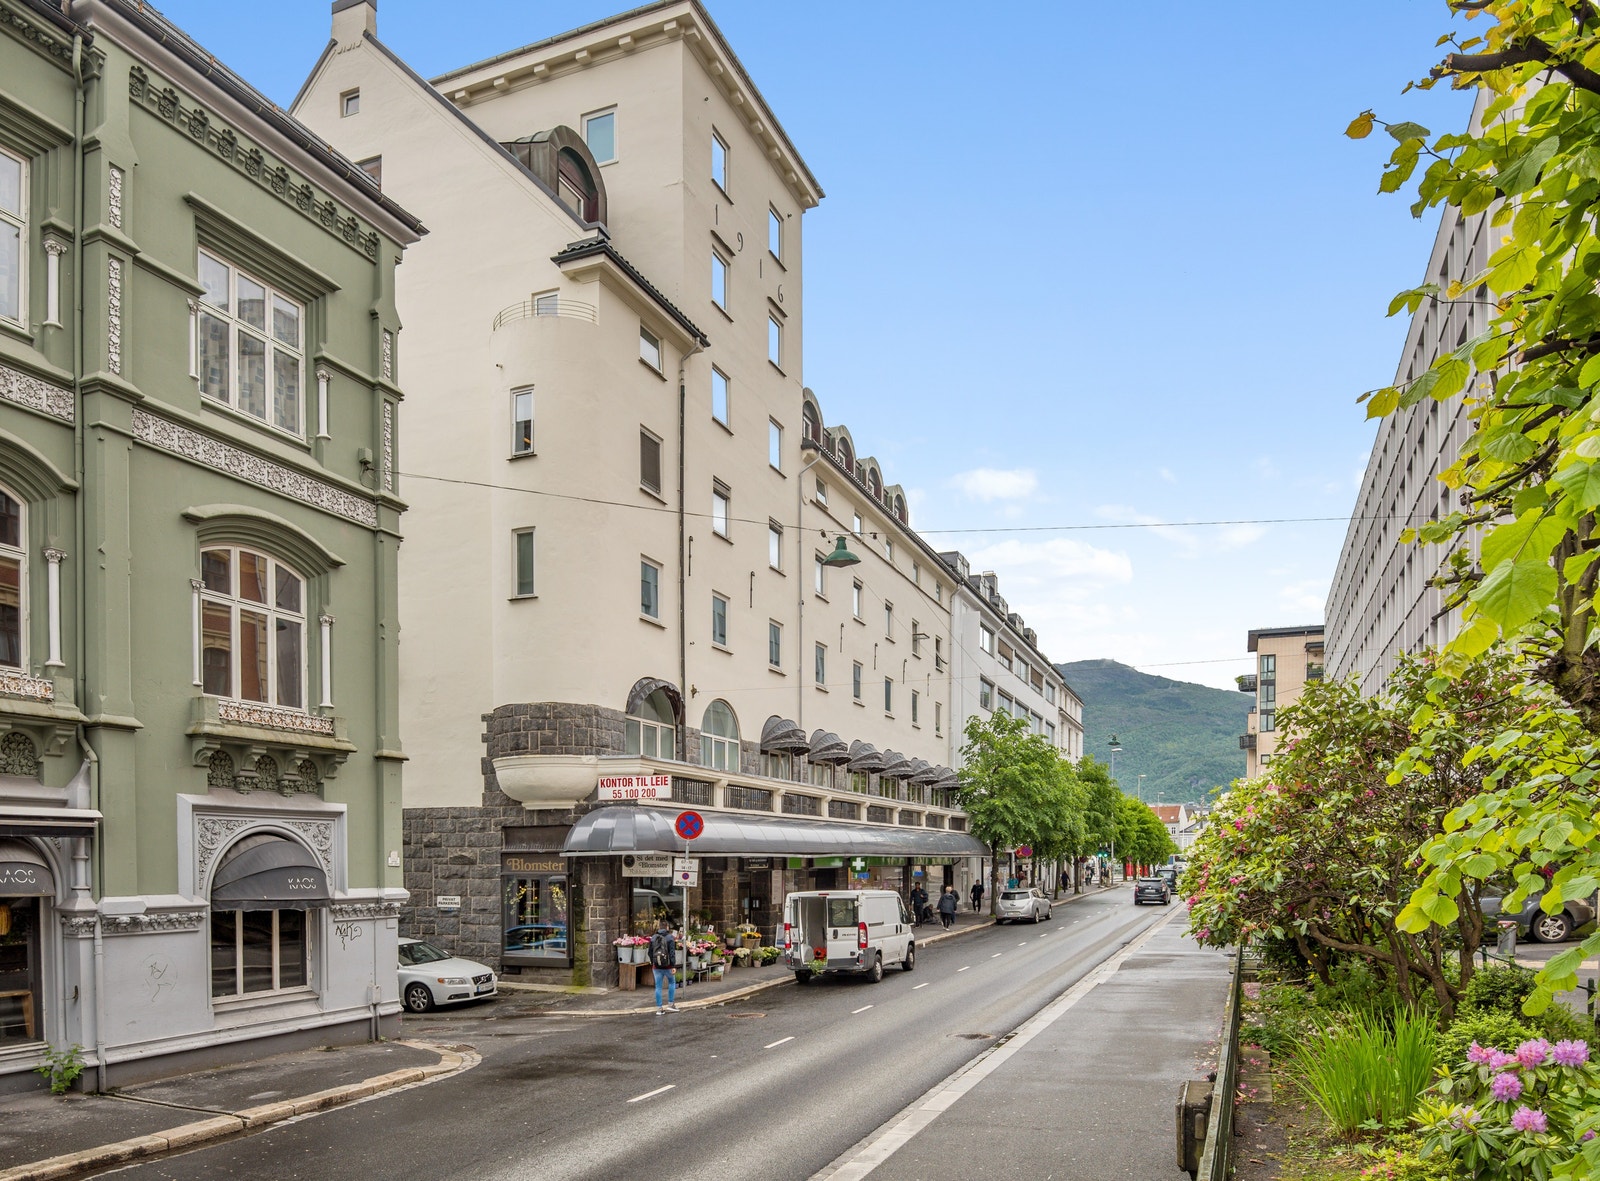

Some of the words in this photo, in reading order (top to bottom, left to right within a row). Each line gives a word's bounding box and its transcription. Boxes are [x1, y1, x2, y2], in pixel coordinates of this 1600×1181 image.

[600, 777, 633, 788] KONTOR
[635, 777, 648, 787] TIL
[651, 776, 669, 787] LEIE
[612, 789, 622, 799] 55
[625, 788, 639, 798] 100
[641, 788, 656, 798] 200
[506, 858, 565, 871] Blomster
[288, 877, 317, 889] KAOS
